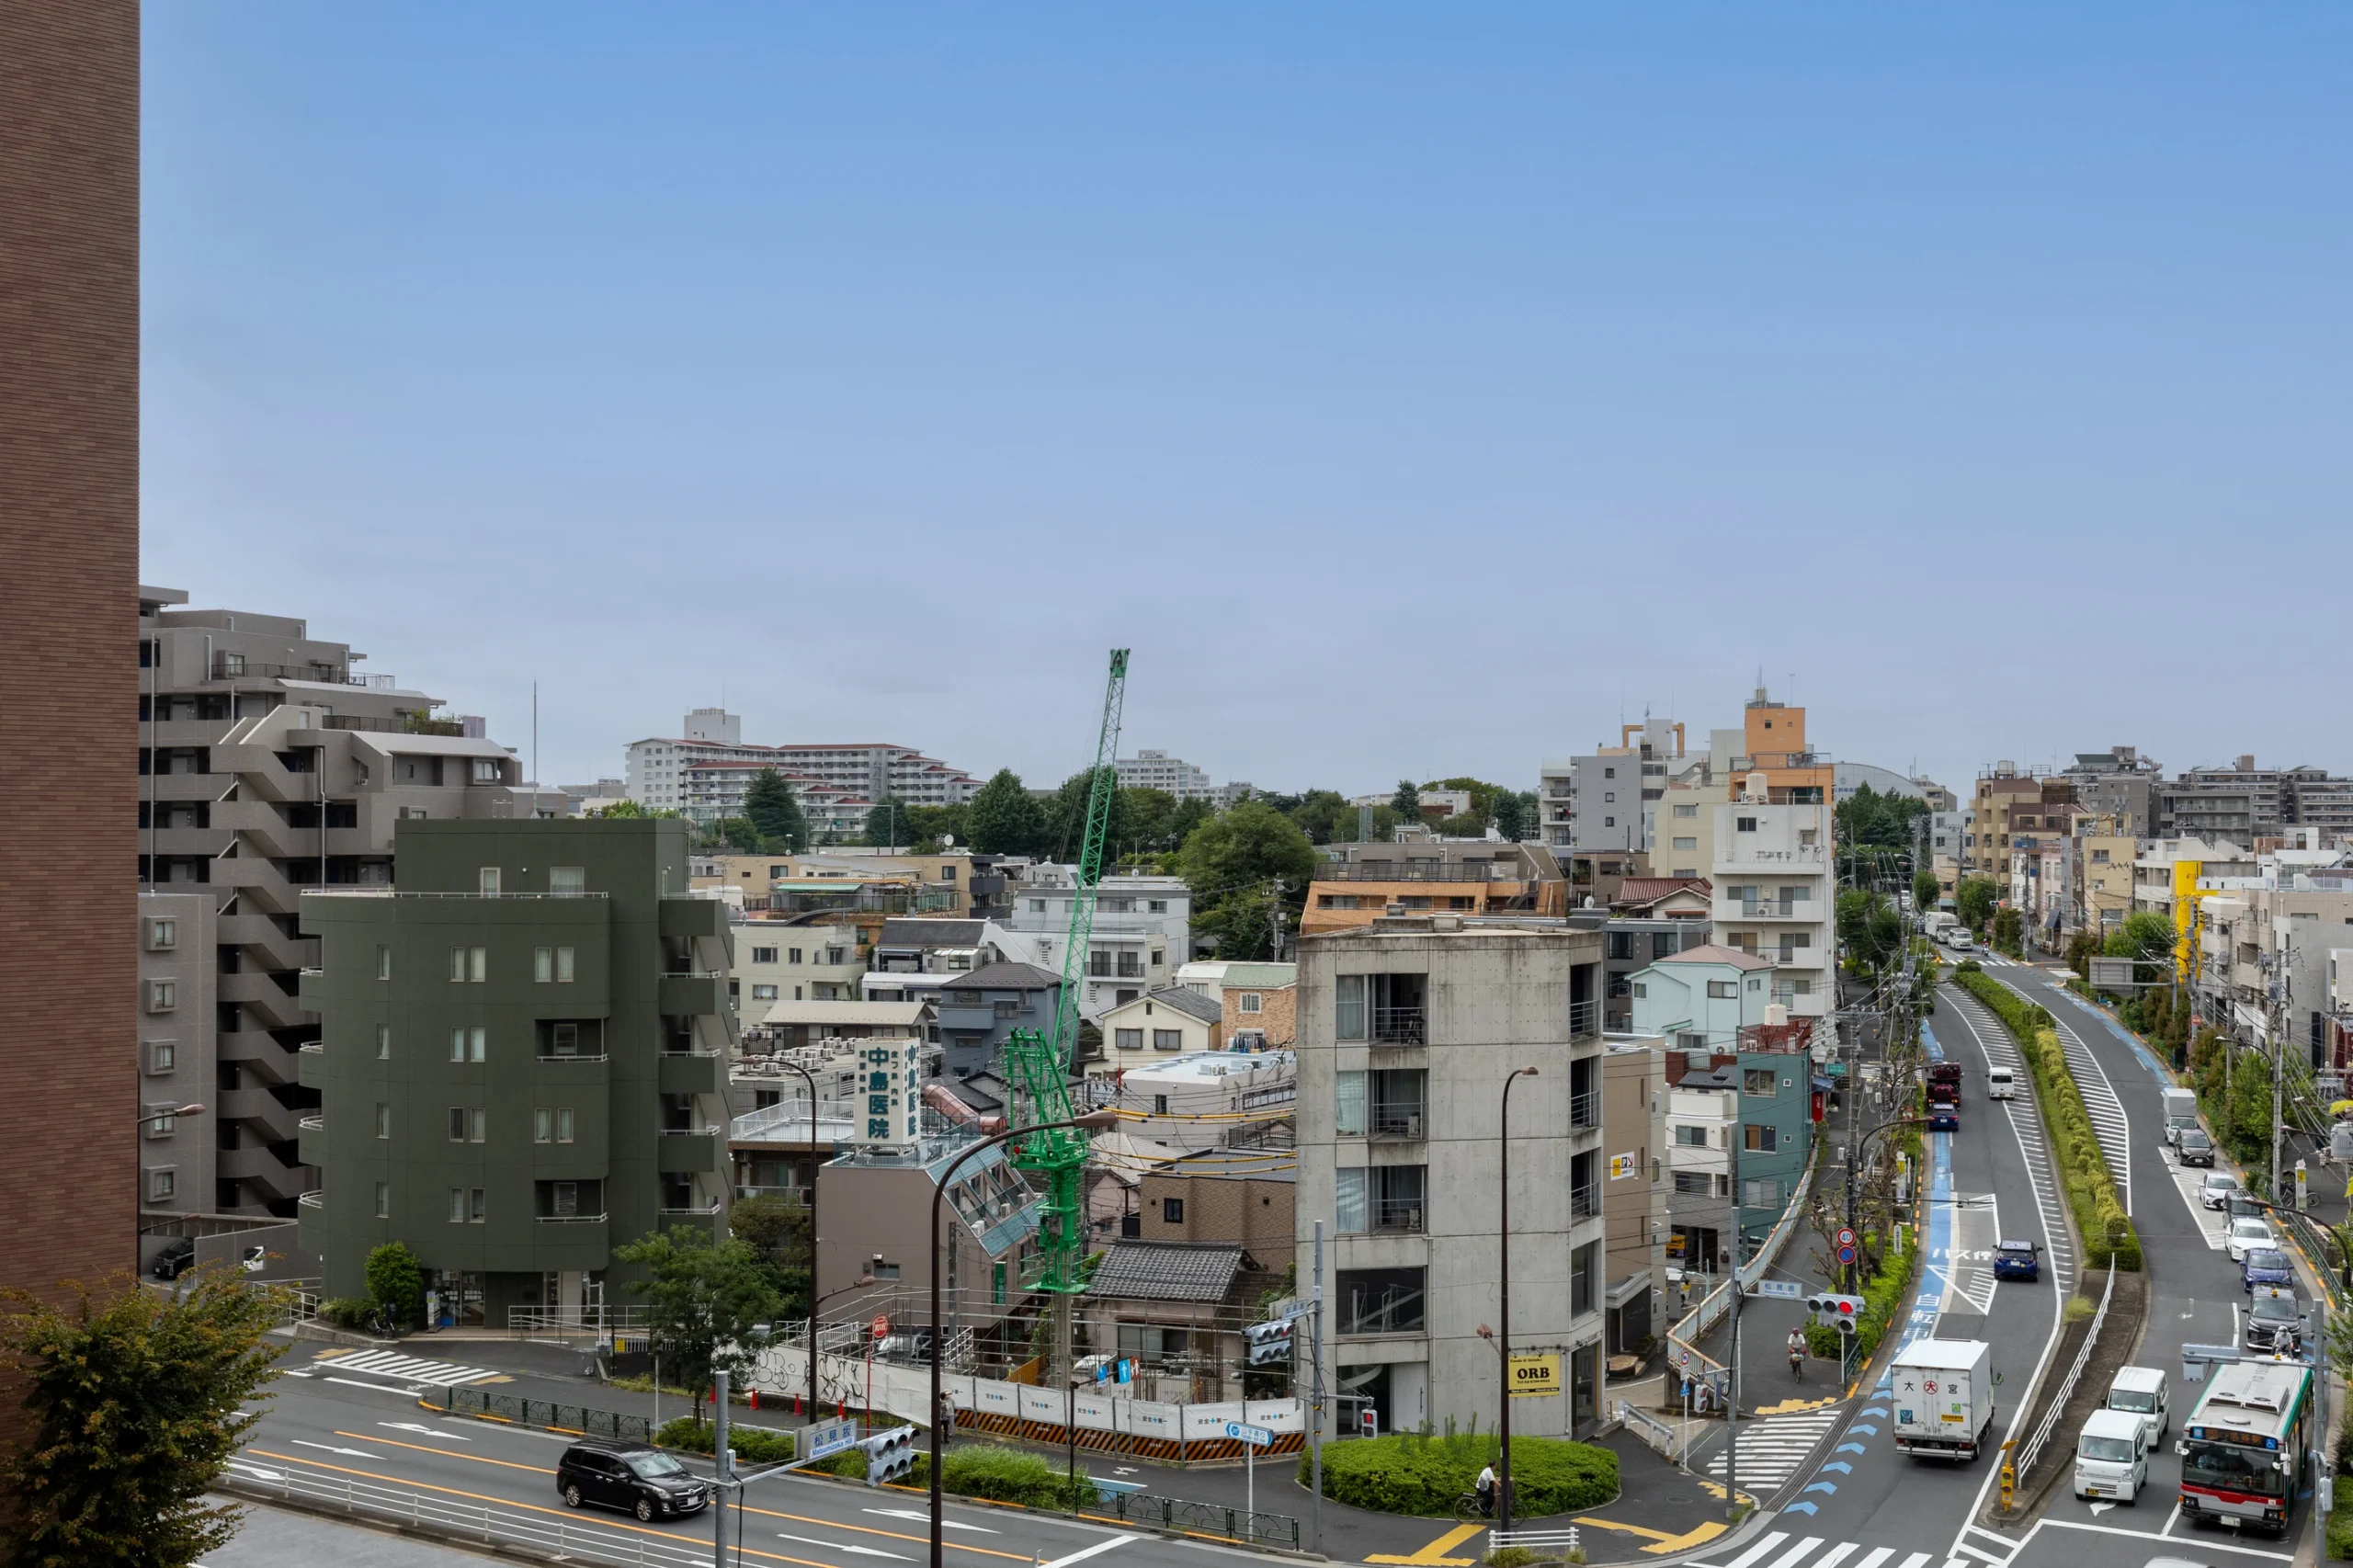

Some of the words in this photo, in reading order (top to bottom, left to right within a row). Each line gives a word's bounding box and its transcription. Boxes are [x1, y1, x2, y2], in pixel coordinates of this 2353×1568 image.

[868, 1046, 890, 1139] 中島医院
[1841, 1233, 1851, 1242] 40
[1517, 1367, 1550, 1380] ORB
[1904, 1381, 1914, 1392] 大
[1948, 1384, 1958, 1394] 宮
[814, 1425, 852, 1448] 松見坂
